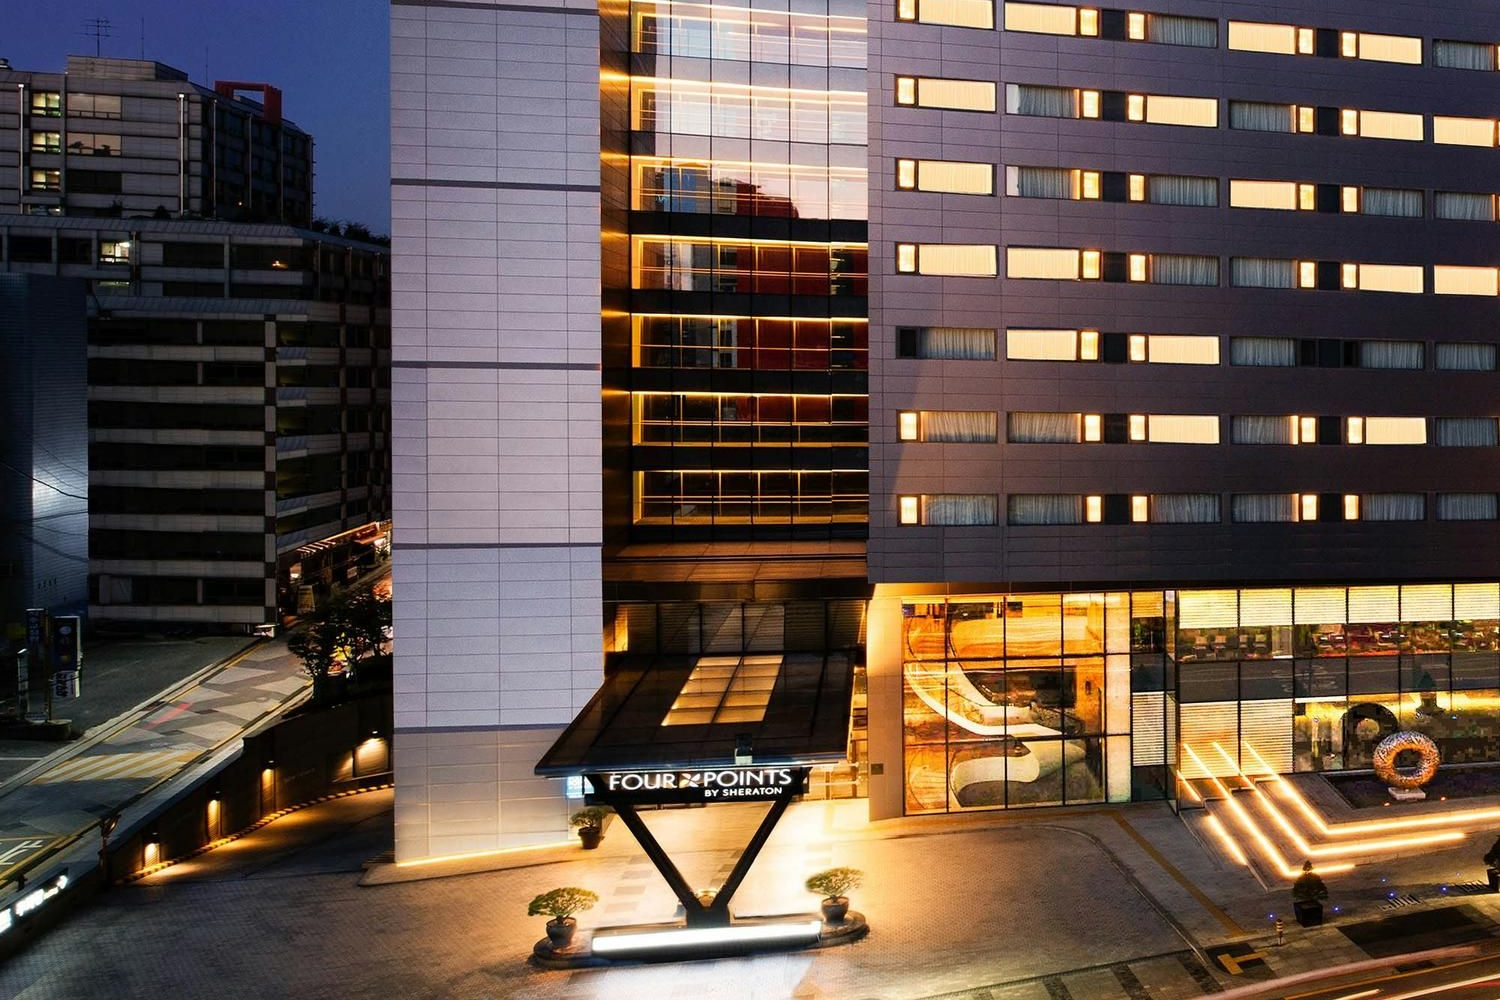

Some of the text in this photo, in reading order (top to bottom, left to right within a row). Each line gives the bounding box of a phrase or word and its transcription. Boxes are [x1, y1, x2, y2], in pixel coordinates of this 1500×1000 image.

[609, 768, 792, 791] FOUR POINTS
[704, 786, 783, 798] BY SHERATON
